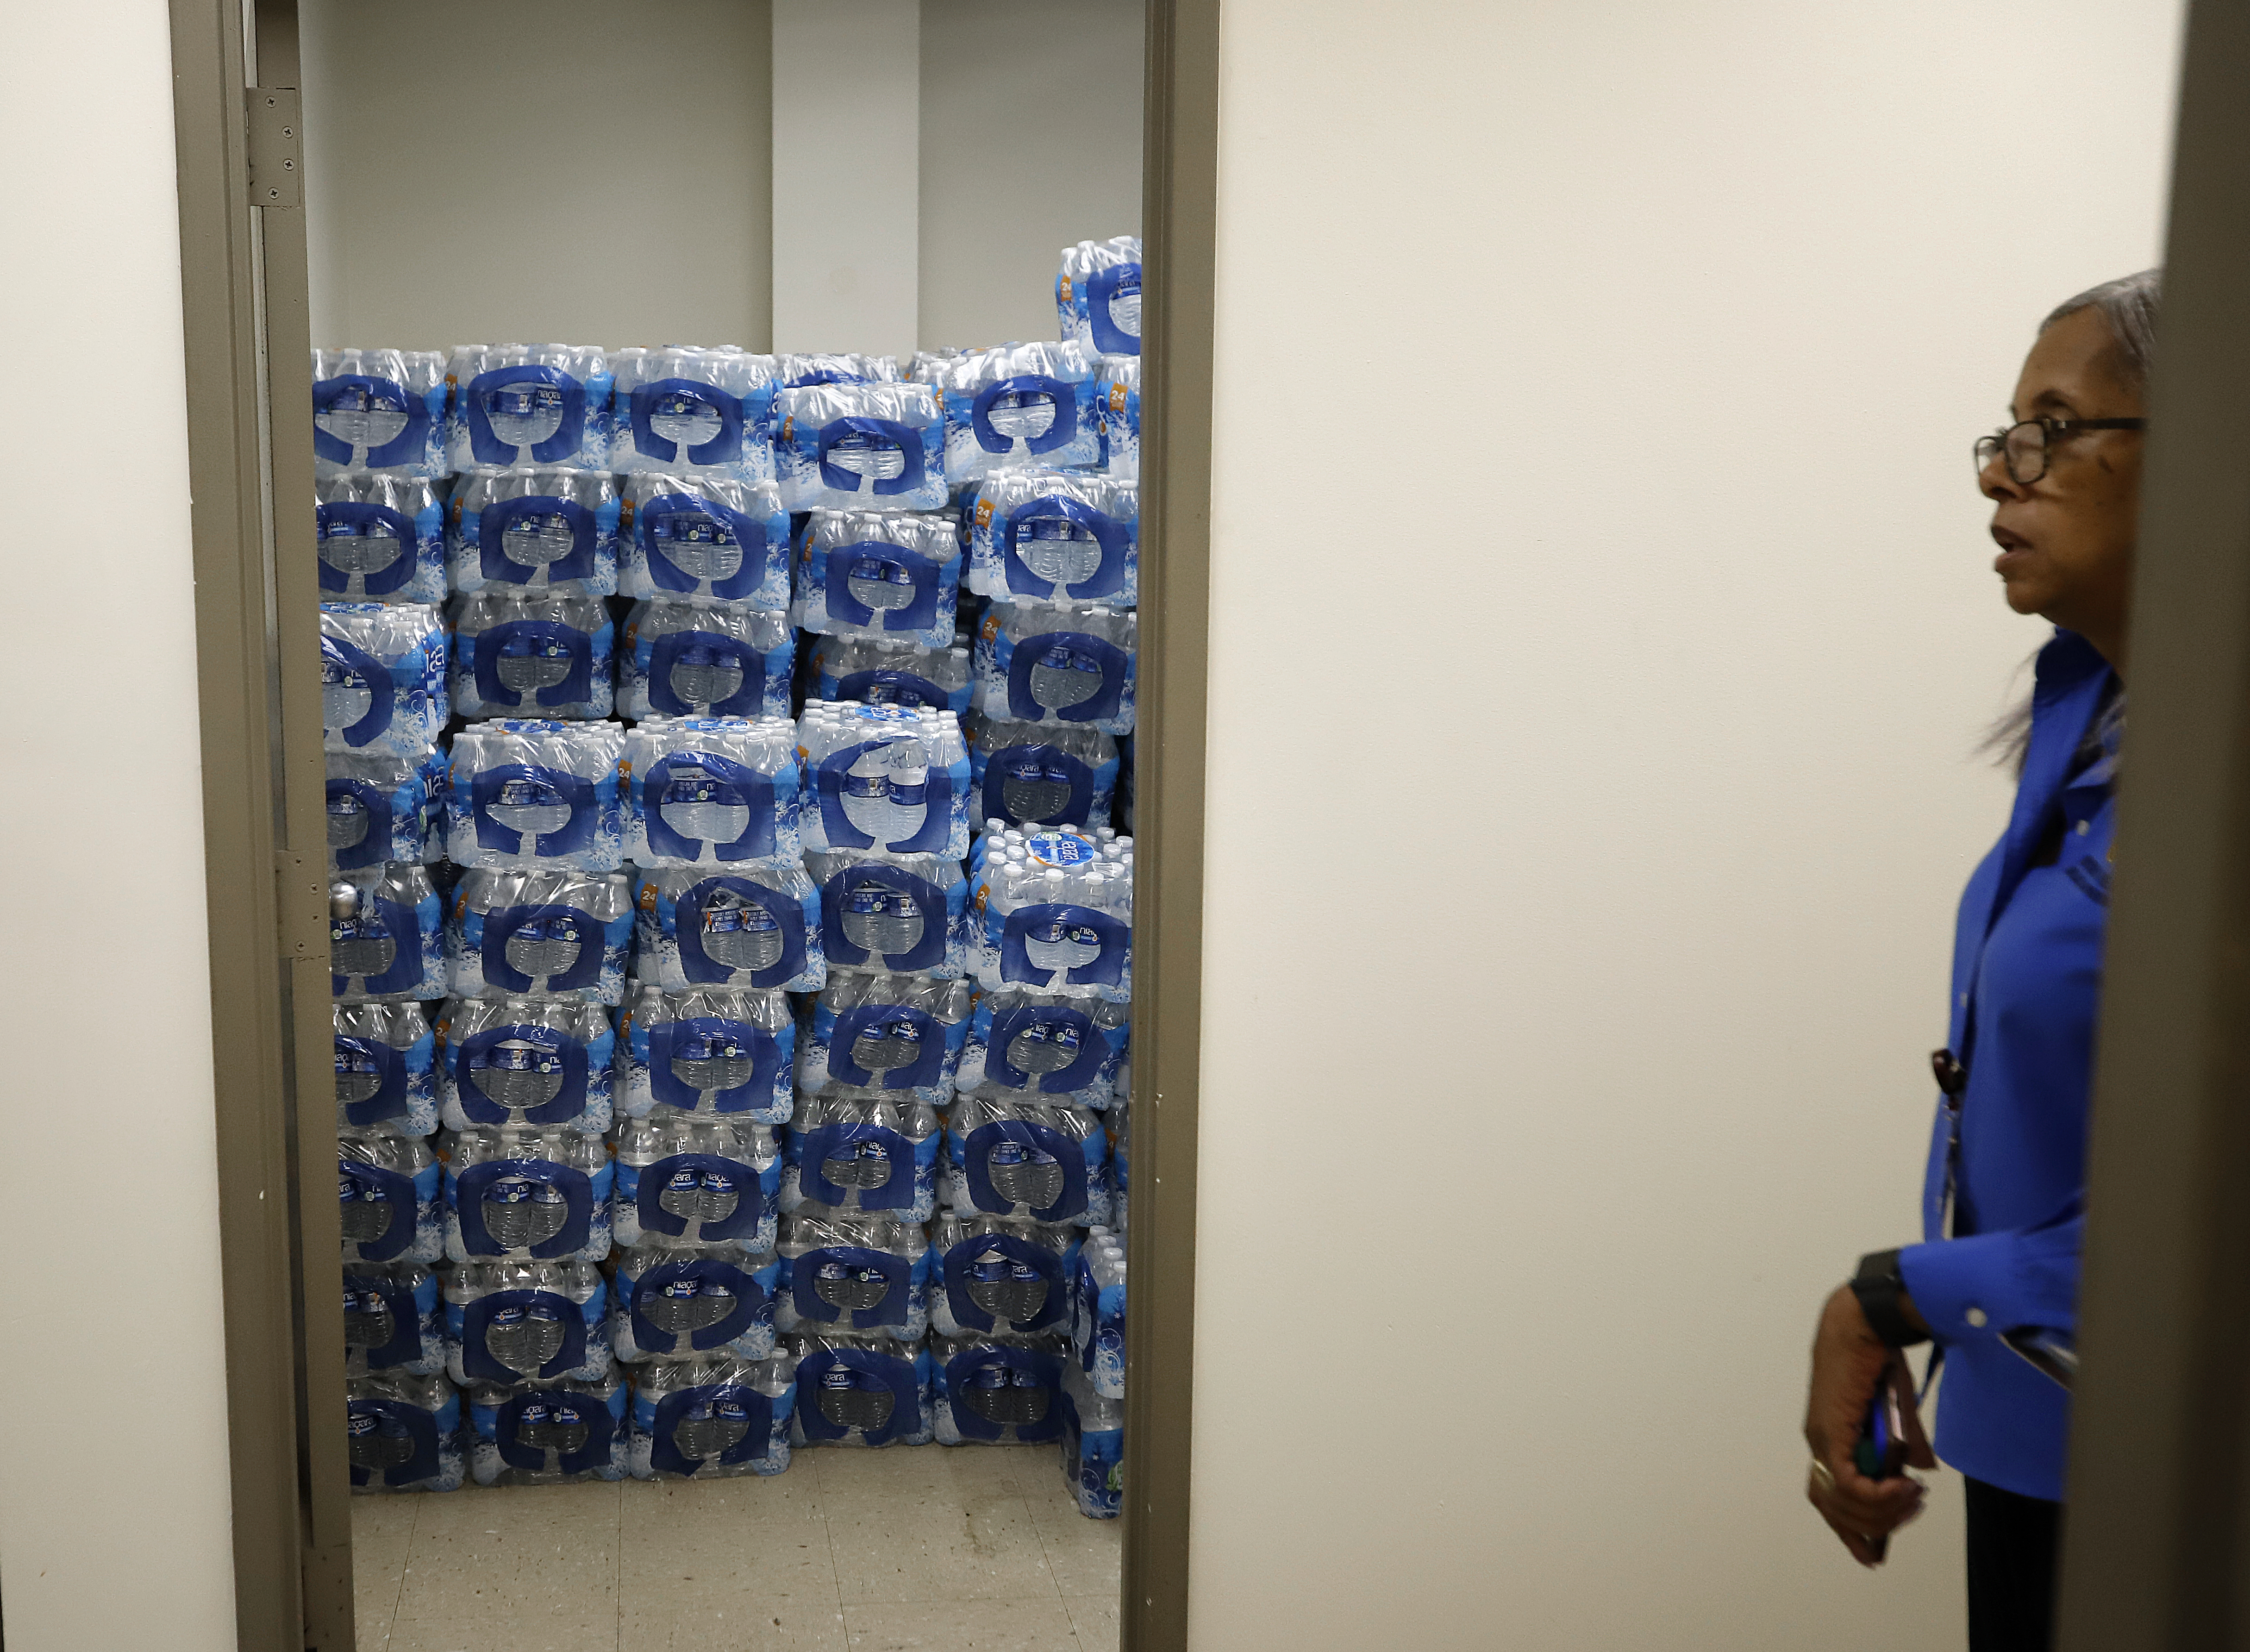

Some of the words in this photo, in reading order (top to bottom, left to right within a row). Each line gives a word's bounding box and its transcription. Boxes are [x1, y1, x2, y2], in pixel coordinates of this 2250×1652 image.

[1061, 282, 1072, 291] 24
[1112, 390, 1125, 400] 24
[455, 505, 461, 513] 2
[621, 506, 633, 516] 24
[978, 506, 990, 518] 24
[985, 621, 998, 634] 24
[619, 767, 630, 779] 24
[643, 890, 656, 901] 24
[460, 900, 466, 908] 2
